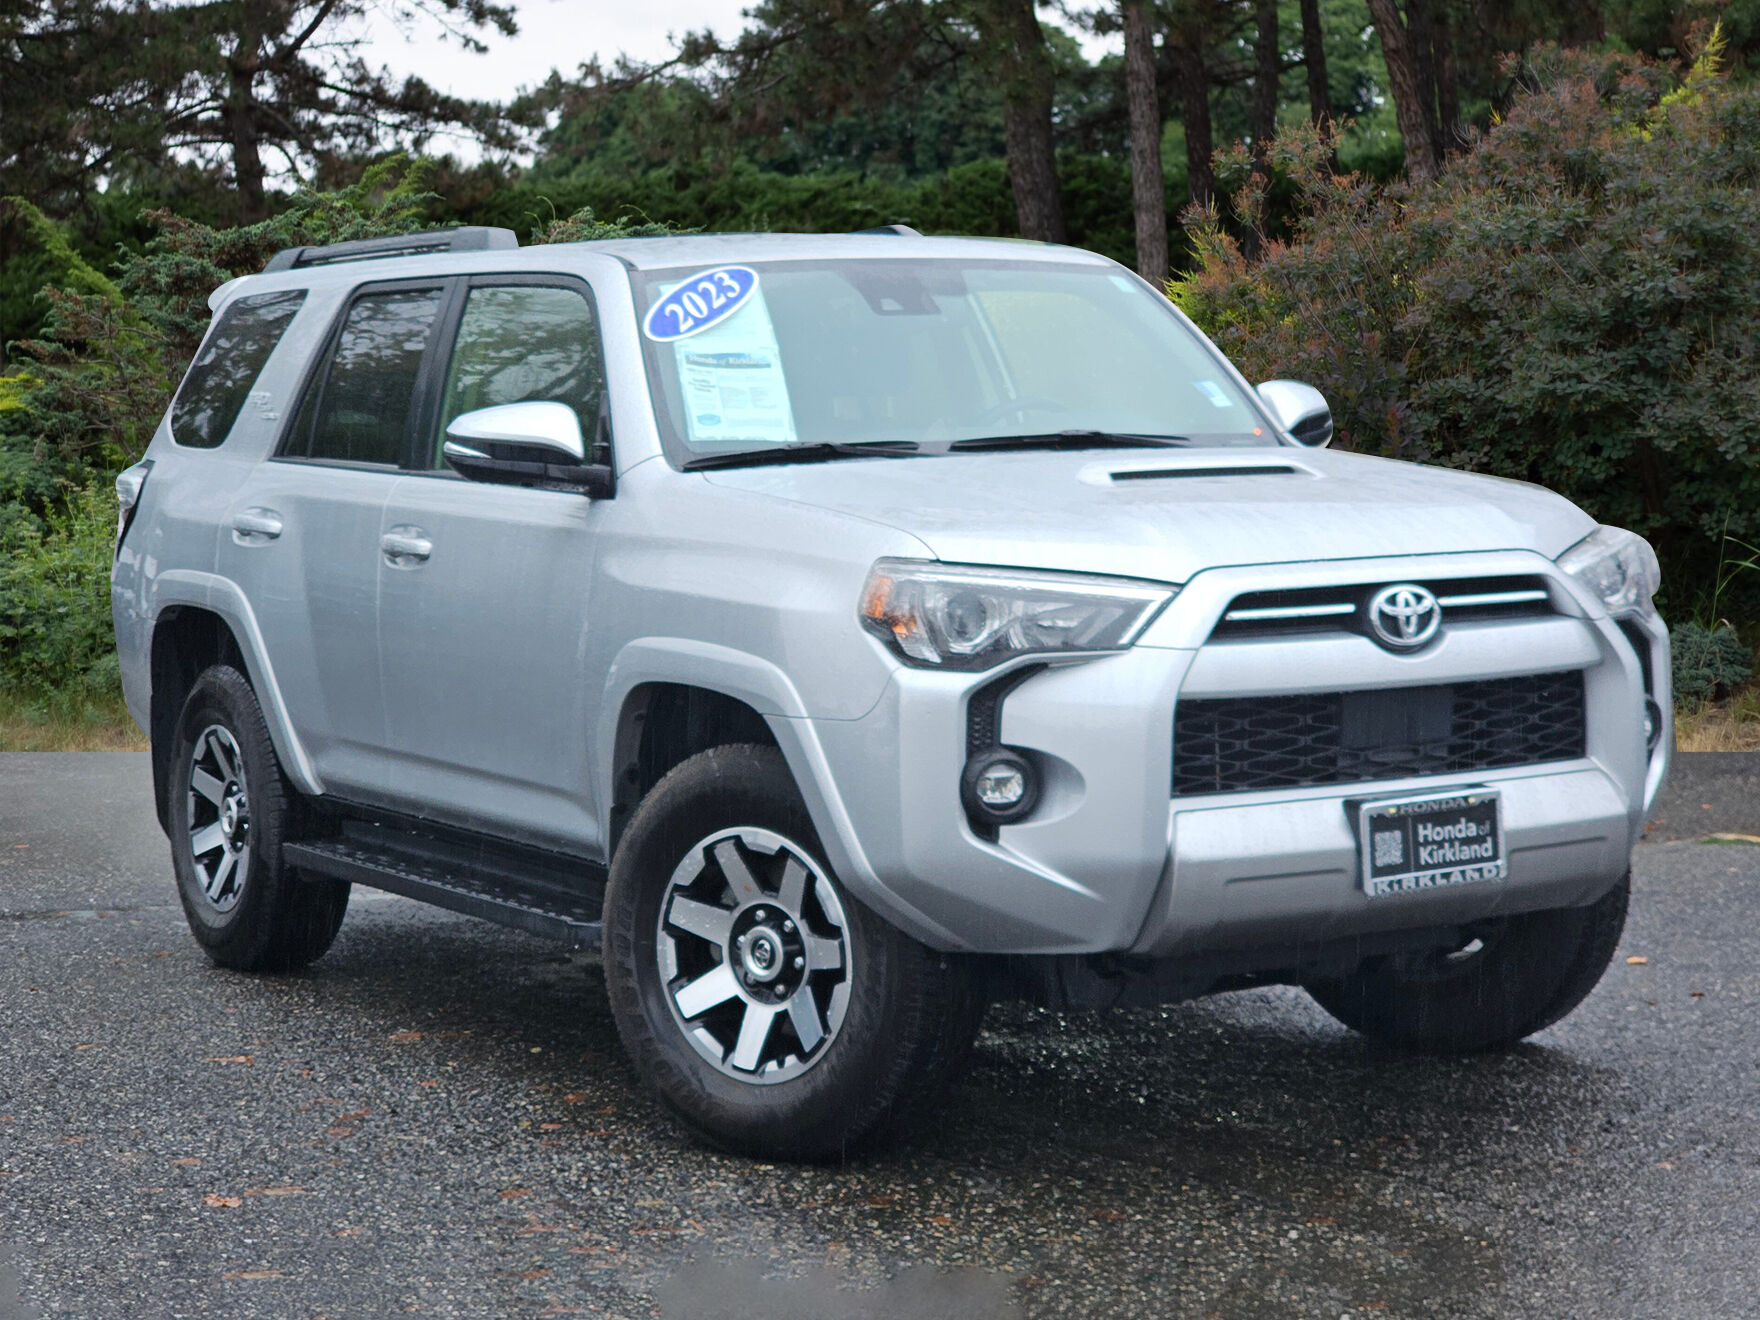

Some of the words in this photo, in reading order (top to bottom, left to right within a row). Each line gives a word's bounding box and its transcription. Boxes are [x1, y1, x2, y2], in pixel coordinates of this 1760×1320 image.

[664, 271, 741, 333] 2023
[1400, 797, 1467, 815] HONDA
[1417, 816, 1477, 843] Honda
[1478, 820, 1491, 836] of
[1418, 836, 1493, 866] Kirkland
[1376, 865, 1498, 894] KIRKLAND
